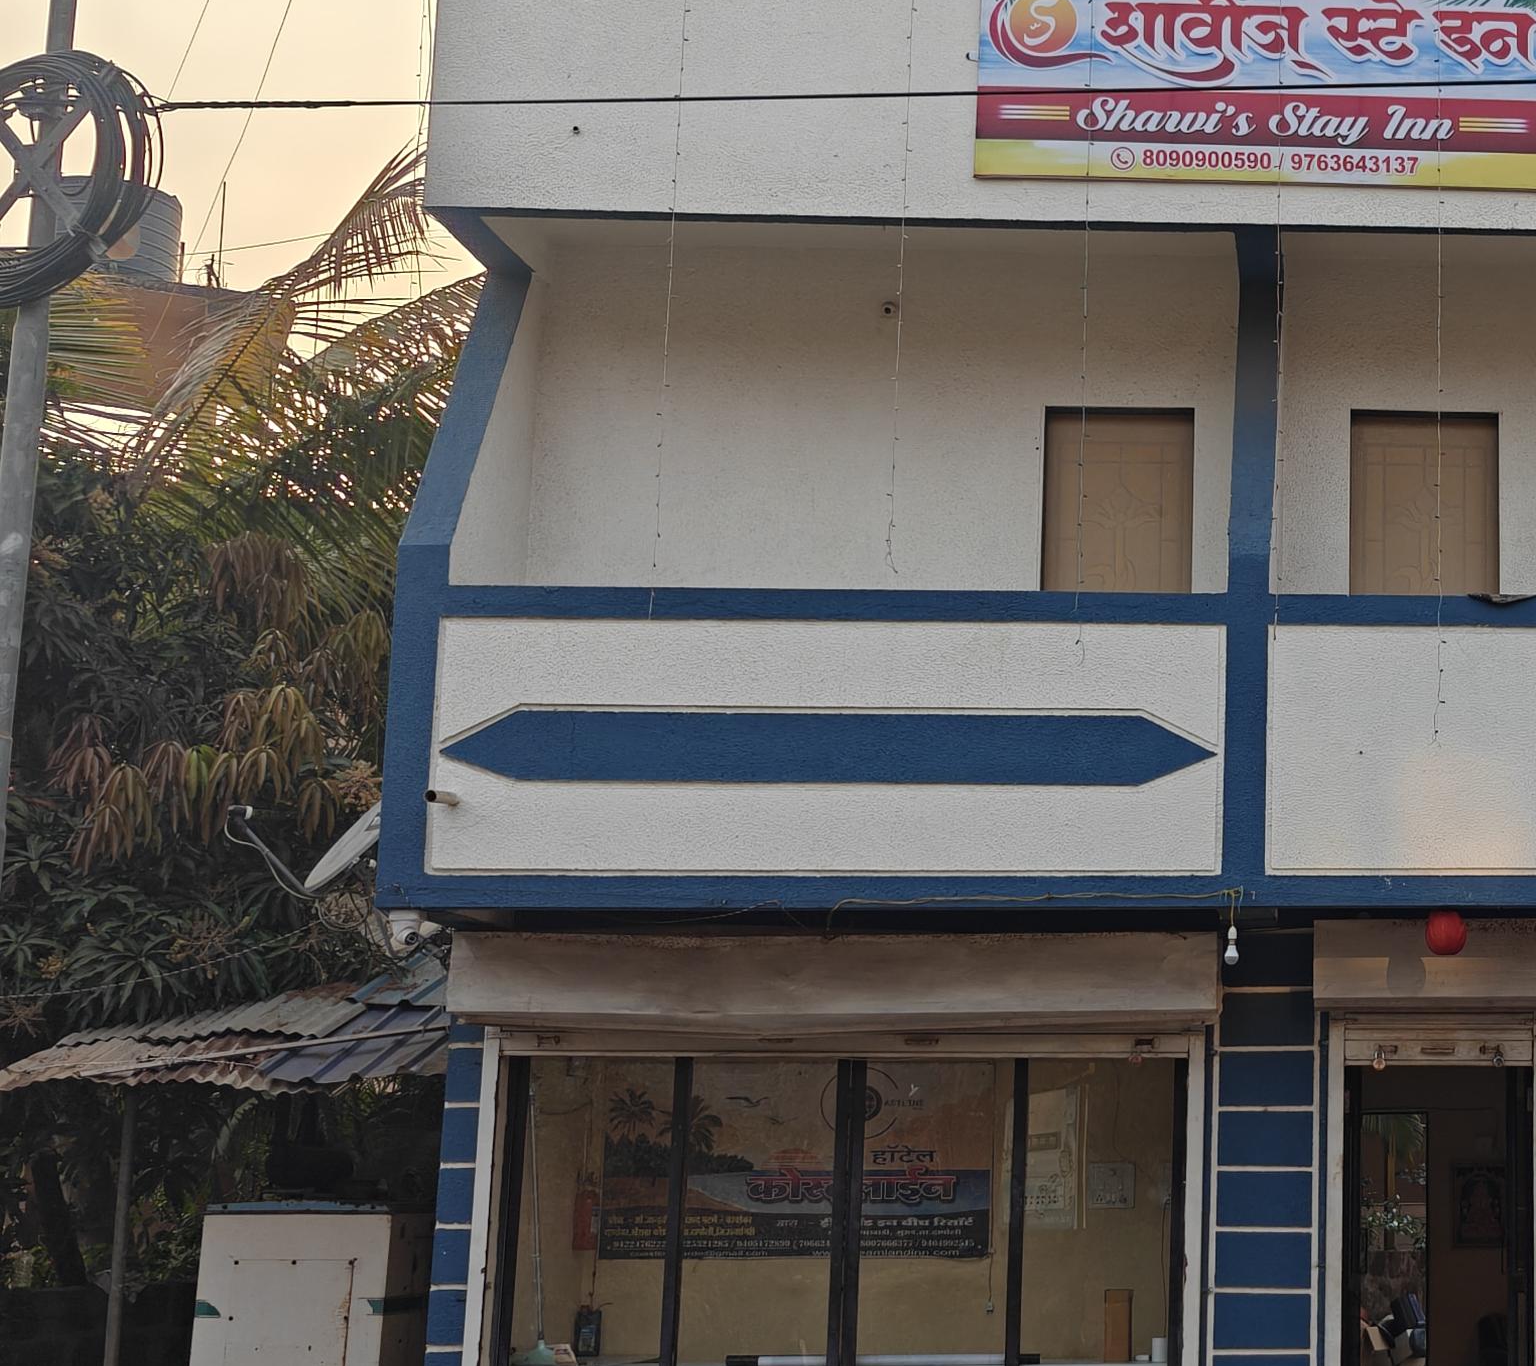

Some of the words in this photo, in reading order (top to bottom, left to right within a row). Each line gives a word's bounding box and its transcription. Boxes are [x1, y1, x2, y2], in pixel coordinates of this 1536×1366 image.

[1076, 96, 1257, 136] Sharvi's
[1268, 101, 1370, 146] Stay
[1383, 104, 1455, 140] Inn
[1142, 149, 1272, 170] 8090900590
[1290, 153, 1419, 174] 9763643137
[870, 1145, 937, 1165] हॉटेल
